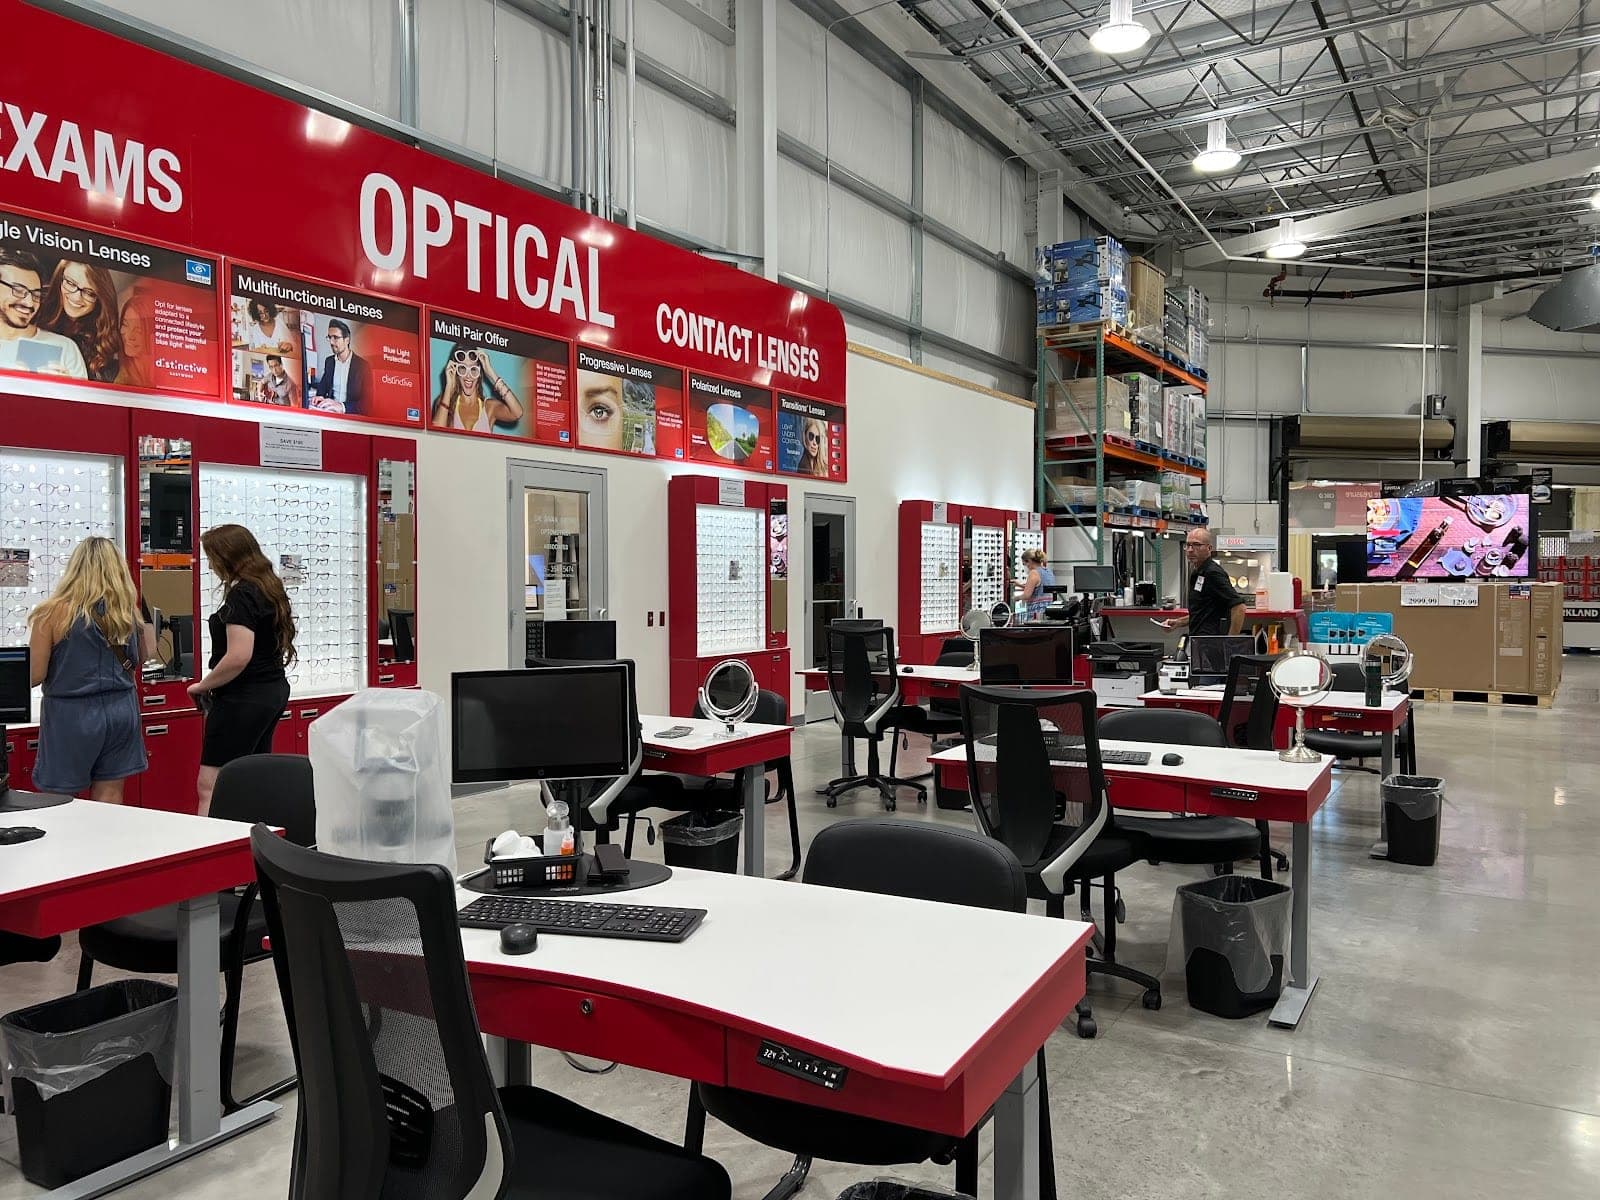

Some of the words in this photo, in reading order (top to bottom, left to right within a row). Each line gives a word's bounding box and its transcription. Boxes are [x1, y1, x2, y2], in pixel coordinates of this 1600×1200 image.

[0, 103, 183, 213] XAMS
[25, 224, 83, 253] Vision
[88, 238, 151, 268] Lenses
[359, 172, 615, 329] OPTICAL
[238, 275, 337, 310] Multifunctional
[340, 302, 383, 320] Lenses
[155, 300, 165, 308] Opt
[176, 304, 192, 313] lenses
[155, 309, 178, 318] adapted
[155, 317, 184, 326] connected
[185, 321, 204, 330] lifestyle
[167, 326, 188, 335] protect
[170, 333, 184, 341] from
[185, 336, 206, 345] harmful
[435, 320, 461, 337] Multi
[463, 325, 482, 342] Pair
[485, 331, 509, 347] Offer
[656, 302, 753, 363] CONTACT
[757, 335, 819, 383] LENSES
[383, 346, 395, 354] Blue
[397, 347, 410, 357] Light
[155, 358, 207, 374] distinctive
[384, 353, 410, 365] Protection
[580, 353, 625, 373] Progressive
[626, 363, 652, 379] Lenses
[382, 374, 412, 387] distinctive
[692, 379, 719, 394] Polarized
[721, 384, 741, 399] Lenses
[809, 404, 825, 416] Lenses
